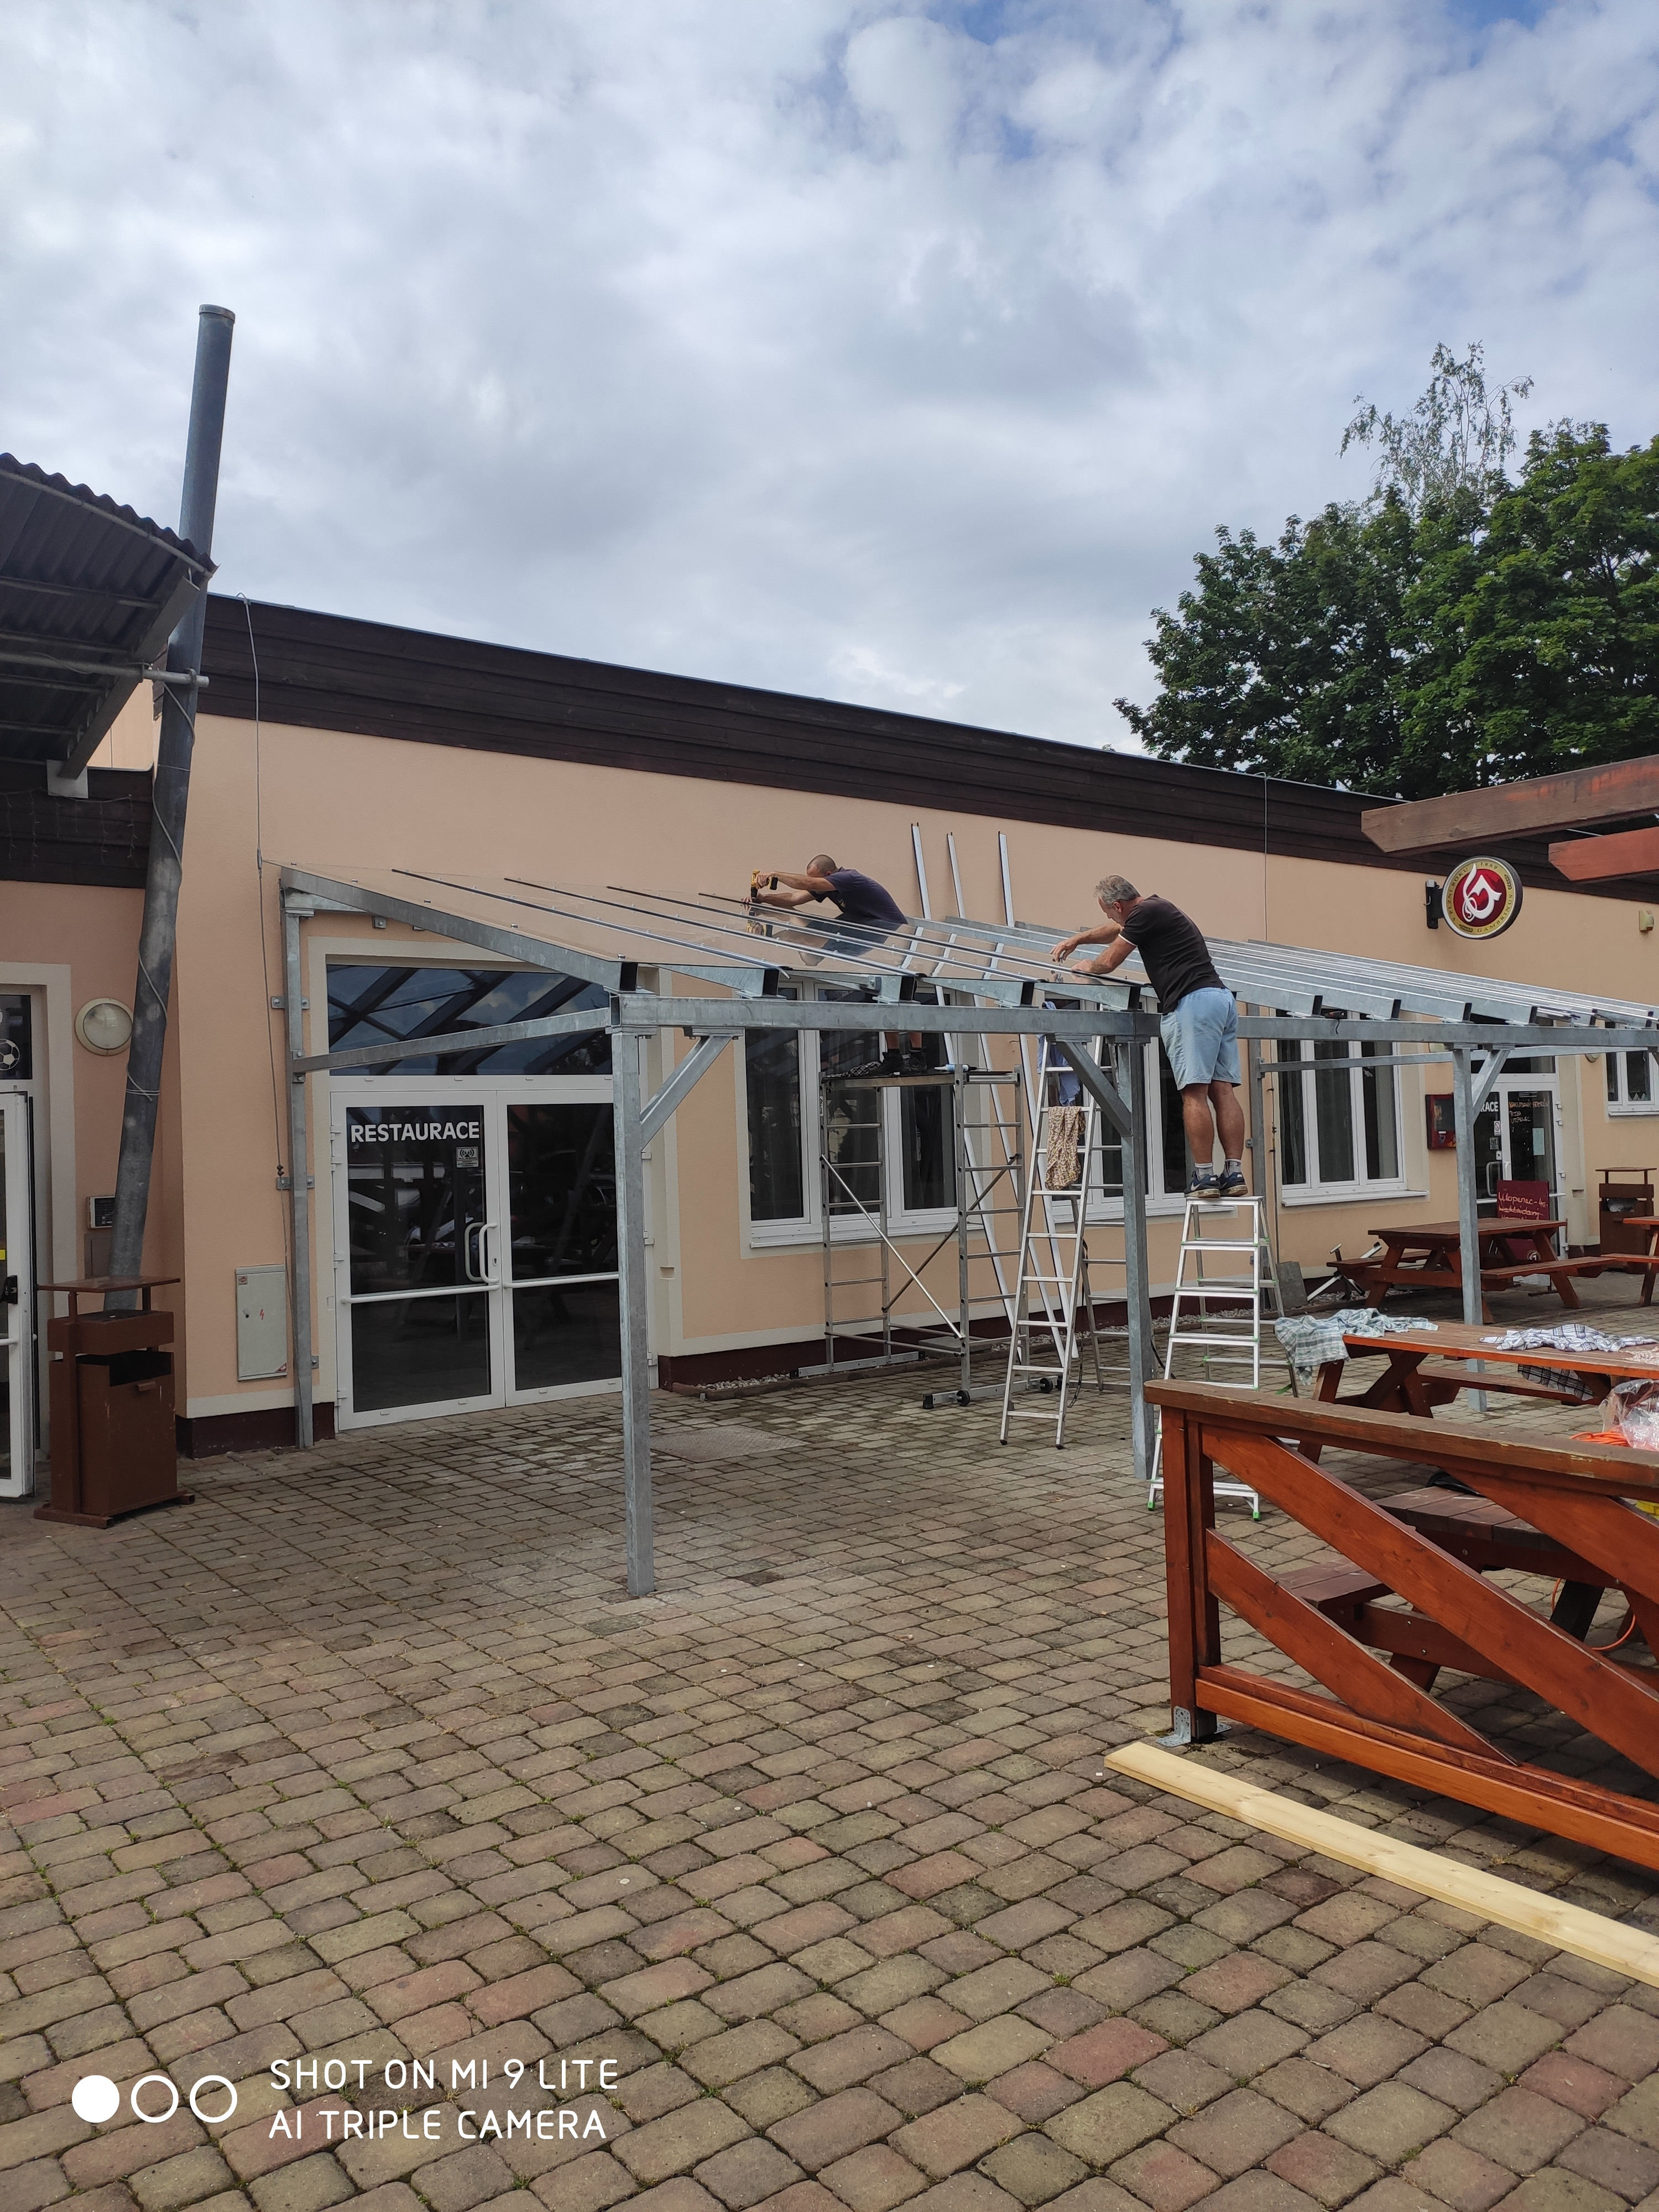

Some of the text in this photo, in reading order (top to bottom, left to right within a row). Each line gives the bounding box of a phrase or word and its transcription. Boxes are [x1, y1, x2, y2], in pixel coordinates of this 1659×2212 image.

[1452, 867, 1468, 887] ROKU
[1477, 894, 1513, 933] GAMBRINUS
[1480, 1100, 1499, 1112] RACE
[351, 1121, 479, 1142] RESTAURACE
